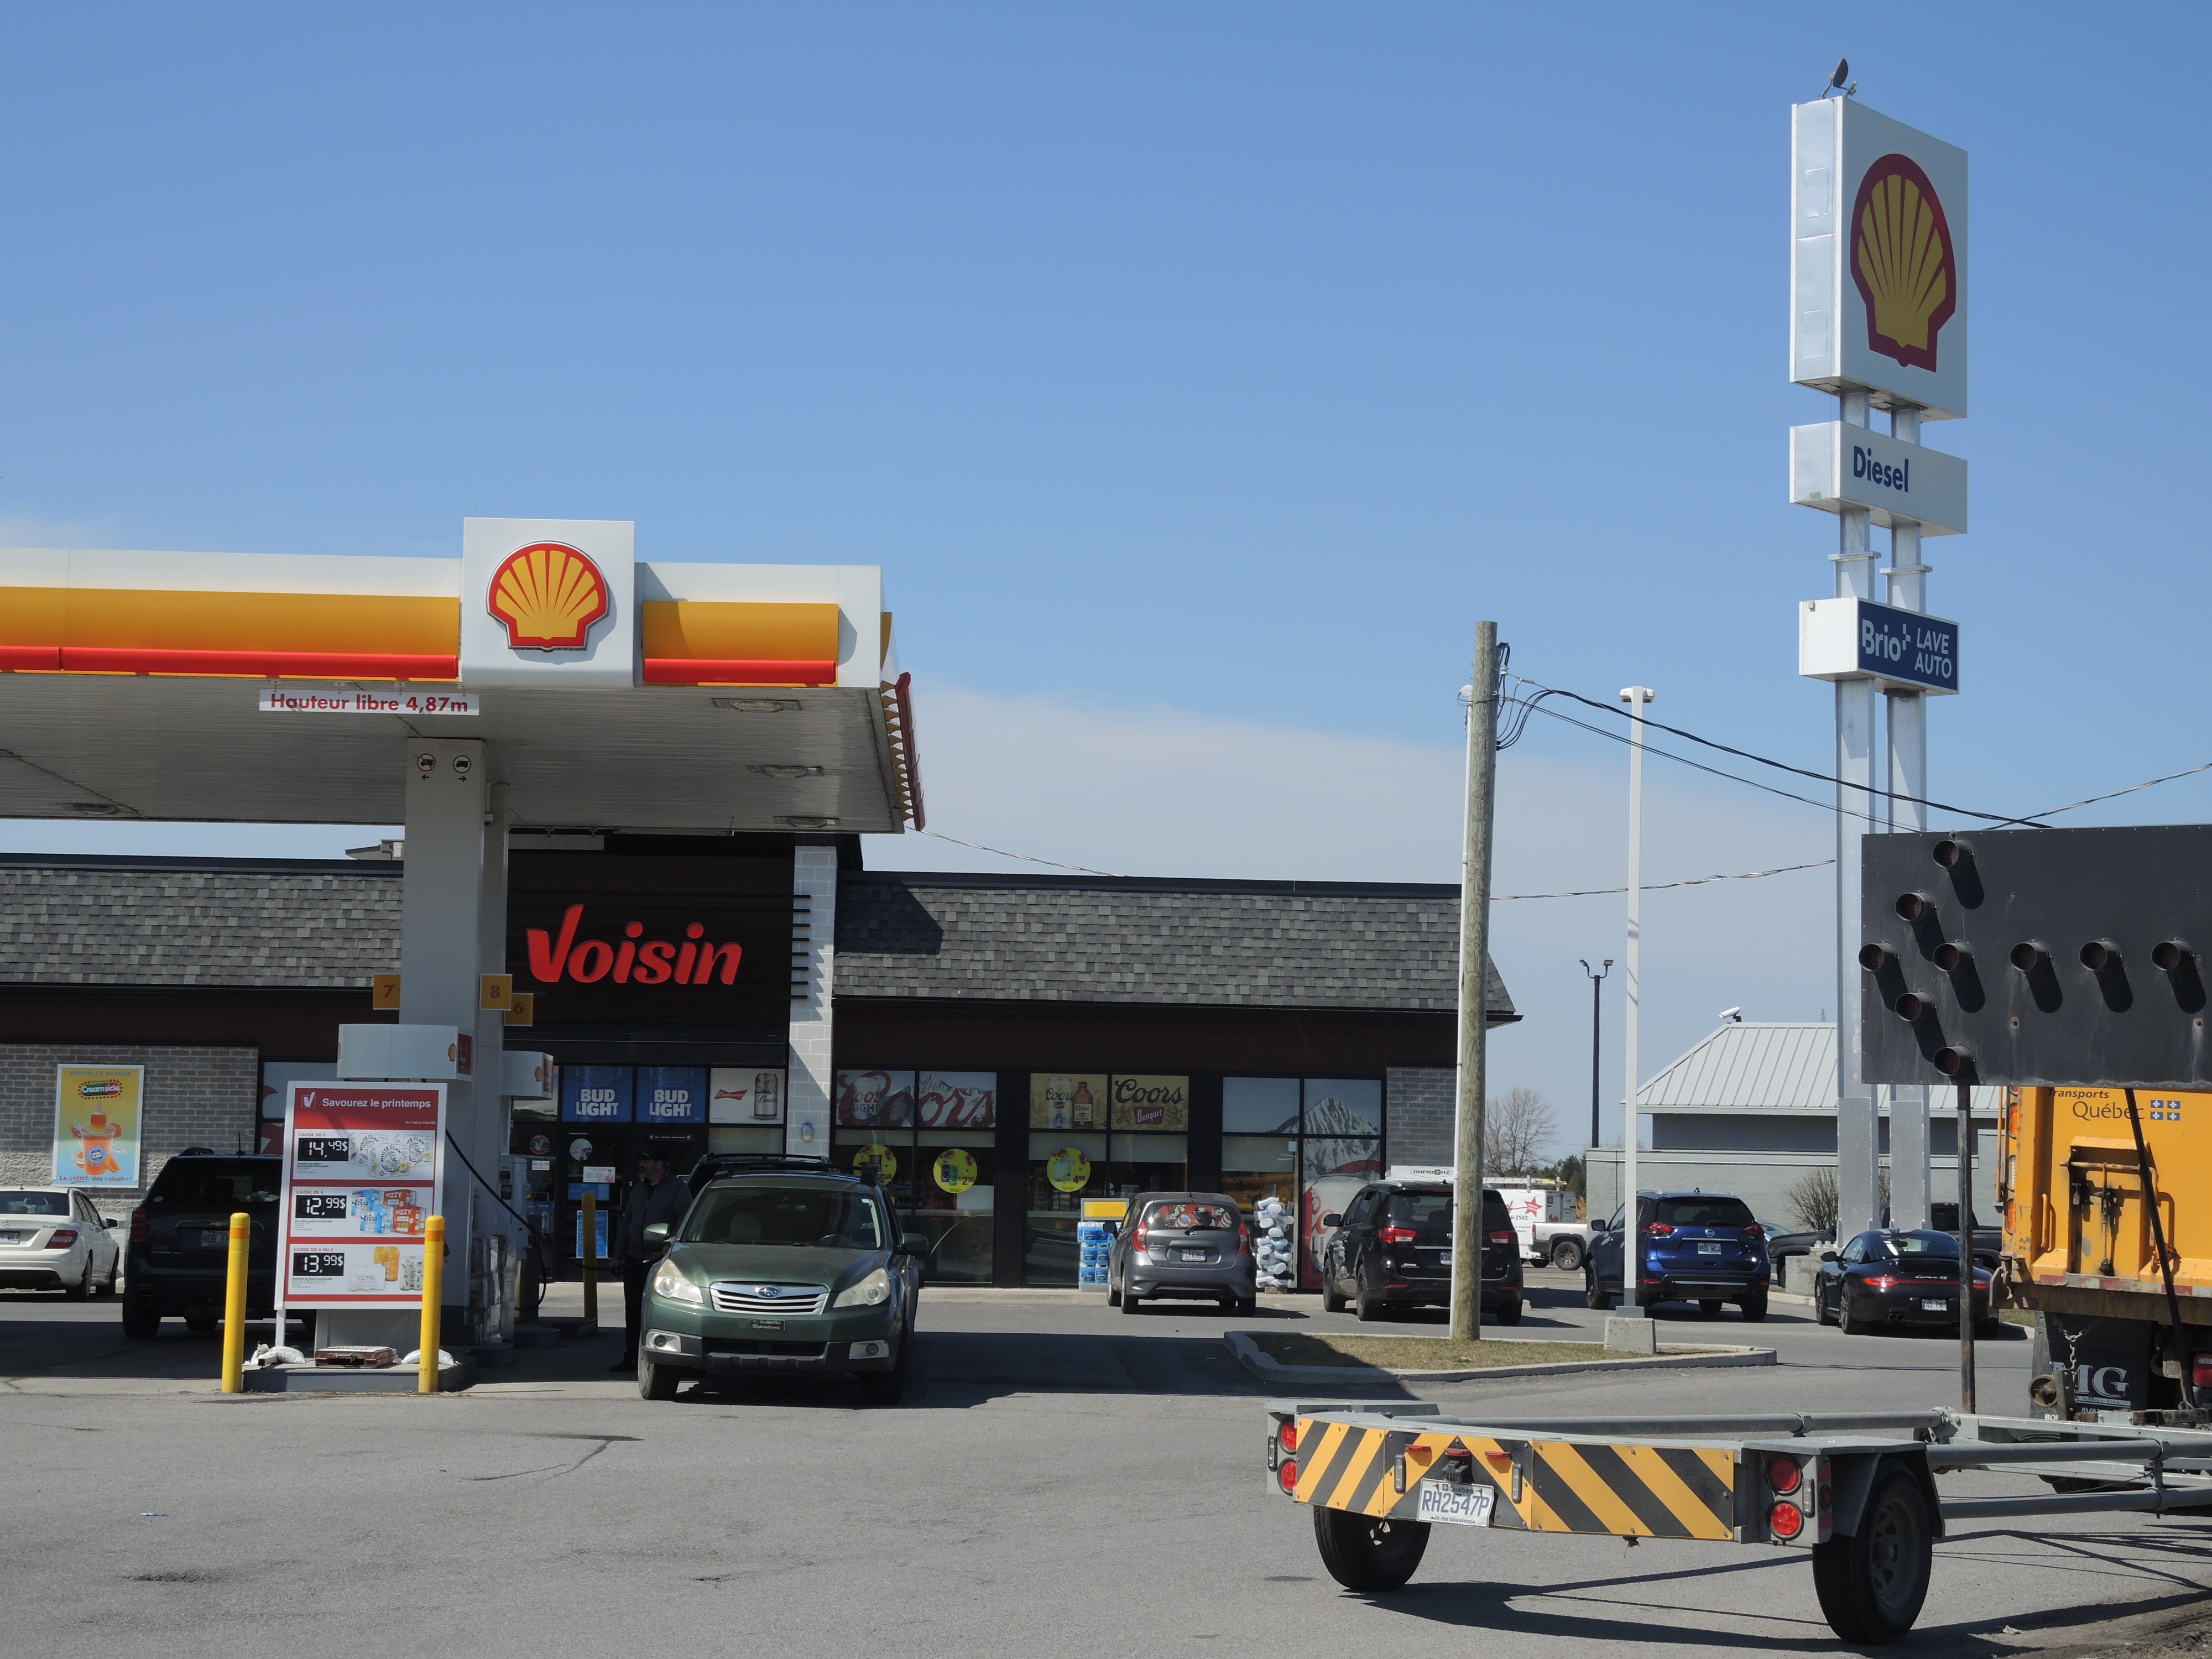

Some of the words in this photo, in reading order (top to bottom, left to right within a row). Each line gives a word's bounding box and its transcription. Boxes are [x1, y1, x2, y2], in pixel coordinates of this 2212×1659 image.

[1853, 445, 1909, 492] Diesel
[1862, 619, 1901, 662] Brio
[1917, 628, 1949, 655] LAVE
[1914, 651, 1952, 679] AUTO
[271, 693, 349, 709] Hauteur
[357, 695, 399, 711] libre
[405, 696, 468, 713] 4,87m
[526, 904, 742, 985] Voisin
[383, 985, 395, 998] 7
[490, 985, 500, 998] 8
[514, 1003, 523, 1014] 6
[82, 1084, 119, 1093] Creamsicle
[581, 1089, 615, 1102] BUD
[1115, 1079, 1183, 1104] Coors
[2048, 1088, 2109, 1099] Transports
[654, 1089, 688, 1103] BUD
[322, 1098, 367, 1107] Savourez
[371, 1099, 379, 1107] le
[382, 1099, 431, 1109] printemps
[576, 1102, 619, 1116] LIGHT
[649, 1103, 692, 1117] LIGHT
[2073, 1101, 2145, 1120] Québec
[1138, 1109, 1162, 1123] Banquet
[380, 1146, 389, 1162] WHITE
[1449, 1485, 1473, 1494] Québec
[1422, 1490, 1490, 1516] RH2547P
